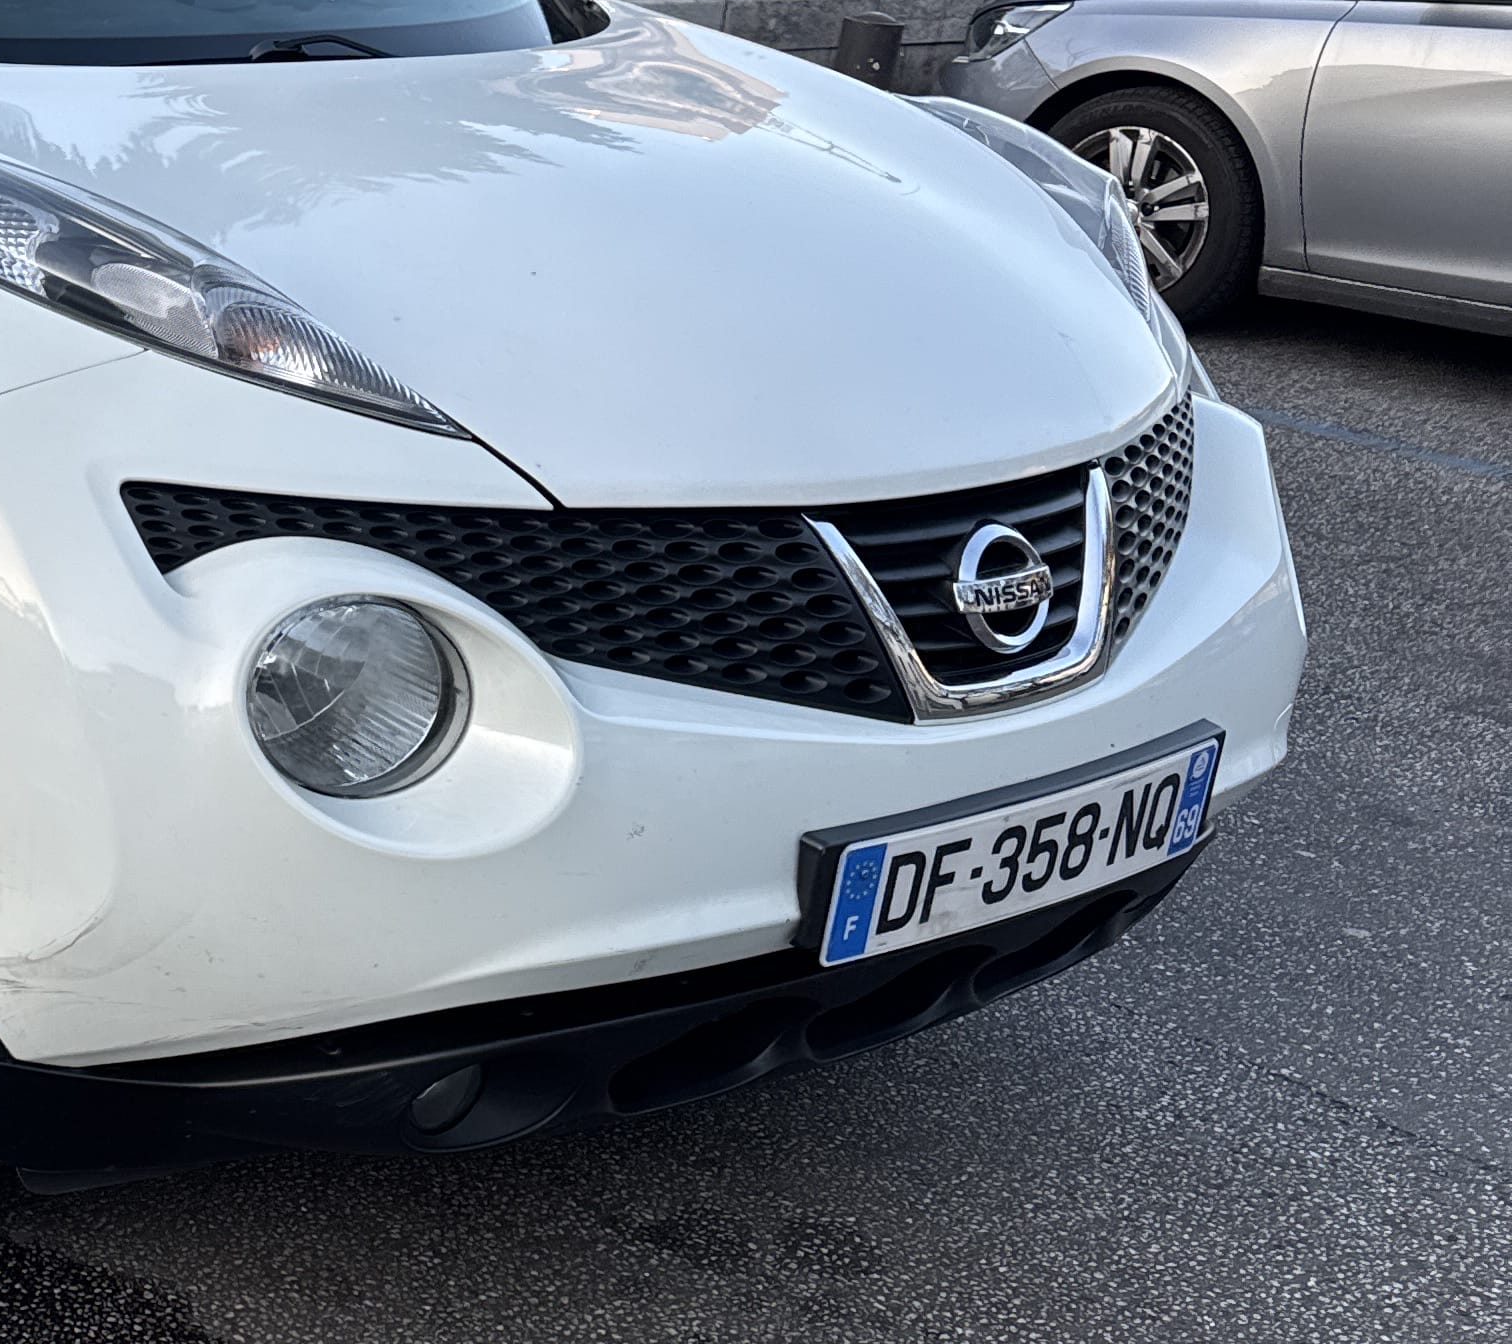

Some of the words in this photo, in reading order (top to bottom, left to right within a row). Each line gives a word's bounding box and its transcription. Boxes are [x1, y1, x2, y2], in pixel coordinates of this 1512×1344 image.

[974, 577, 1051, 608] NISSAN
[1172, 804, 1200, 844] 69
[876, 773, 1181, 935] DF-358-NQ
[843, 915, 860, 941] F
